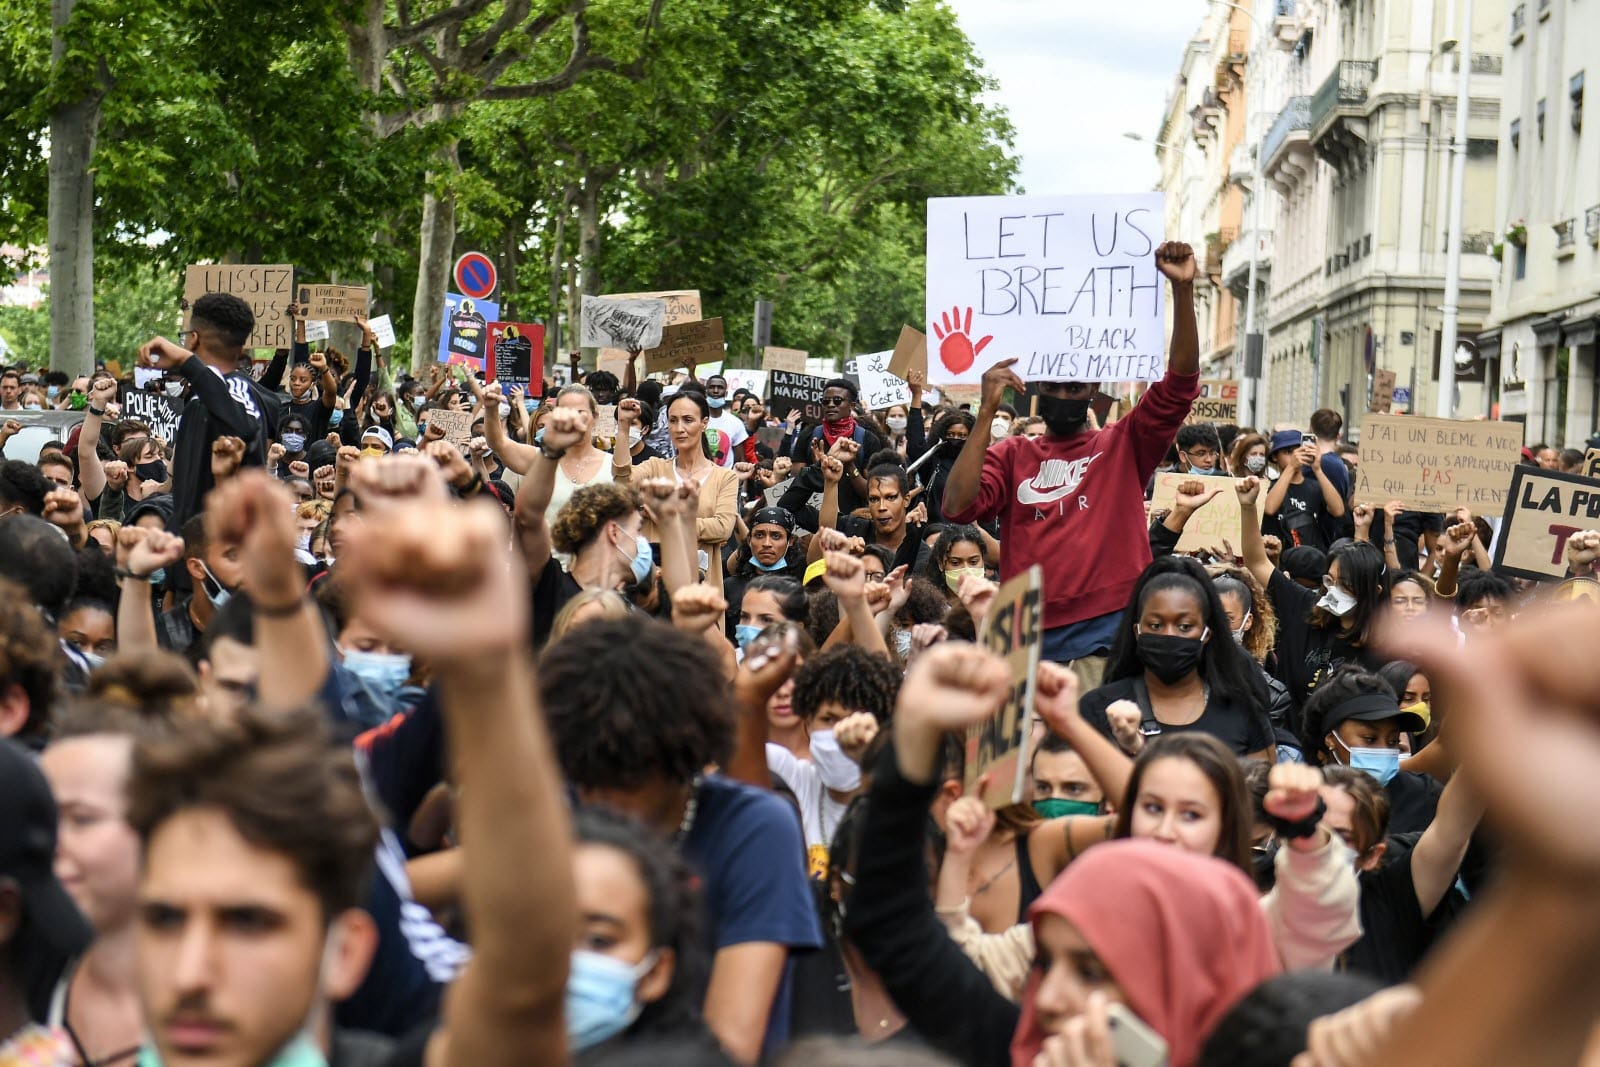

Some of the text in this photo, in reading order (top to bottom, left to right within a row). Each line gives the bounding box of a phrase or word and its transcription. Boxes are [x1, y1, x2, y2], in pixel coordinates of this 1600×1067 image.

[964, 208, 1152, 260] LET US
[976, 265, 1159, 317] BREATH
[254, 300, 281, 320] US
[664, 301, 697, 315] LICING
[250, 323, 286, 346] RER
[1065, 325, 1136, 350] BLACK
[1027, 351, 1161, 379] LIVES MATTER
[774, 371, 788, 384] LA
[792, 387, 809, 401] PAS
[1200, 383, 1239, 399] OLICE
[126, 392, 157, 419] POLICE
[1191, 400, 1237, 420] SASSINE
[1368, 423, 1398, 442] J'AI
[1408, 428, 1428, 444] UN
[1486, 434, 1517, 453] AVEC
[1362, 448, 1384, 464] LES
[1416, 453, 1438, 468] QUI
[1031, 457, 1090, 489] NIKE
[1421, 468, 1453, 485] PAS
[1383, 478, 1404, 494] QUI
[1414, 483, 1436, 497] LES
[1034, 495, 1089, 521] AIR
[1521, 482, 1600, 518] LA PO
